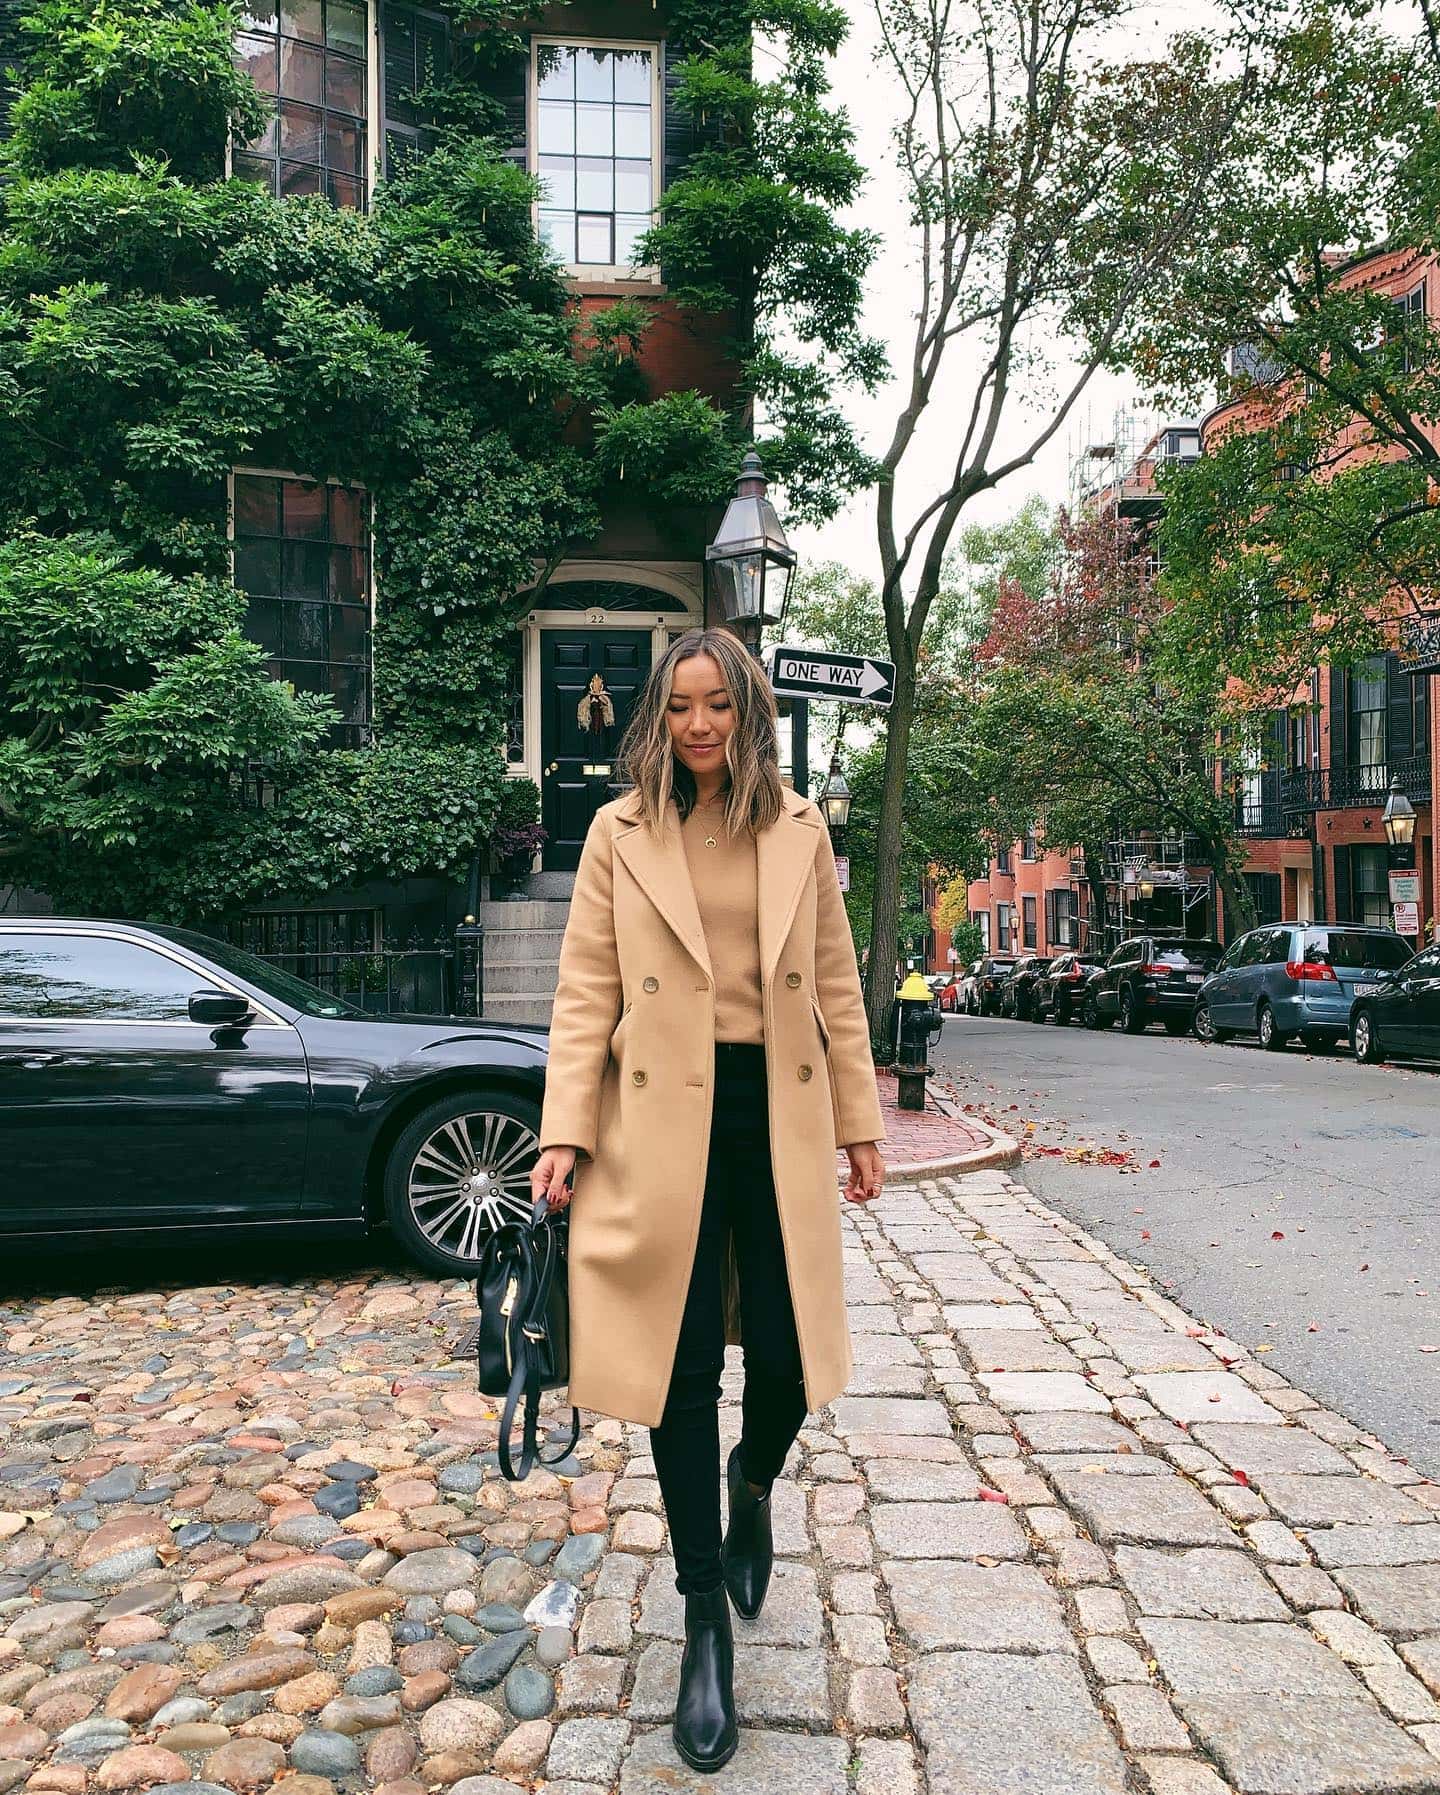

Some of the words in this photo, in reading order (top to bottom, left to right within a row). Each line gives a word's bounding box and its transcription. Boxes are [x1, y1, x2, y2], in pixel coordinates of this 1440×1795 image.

[590, 614, 604, 624] 22
[786, 662, 819, 680] ONE
[829, 666, 864, 686] WAY
